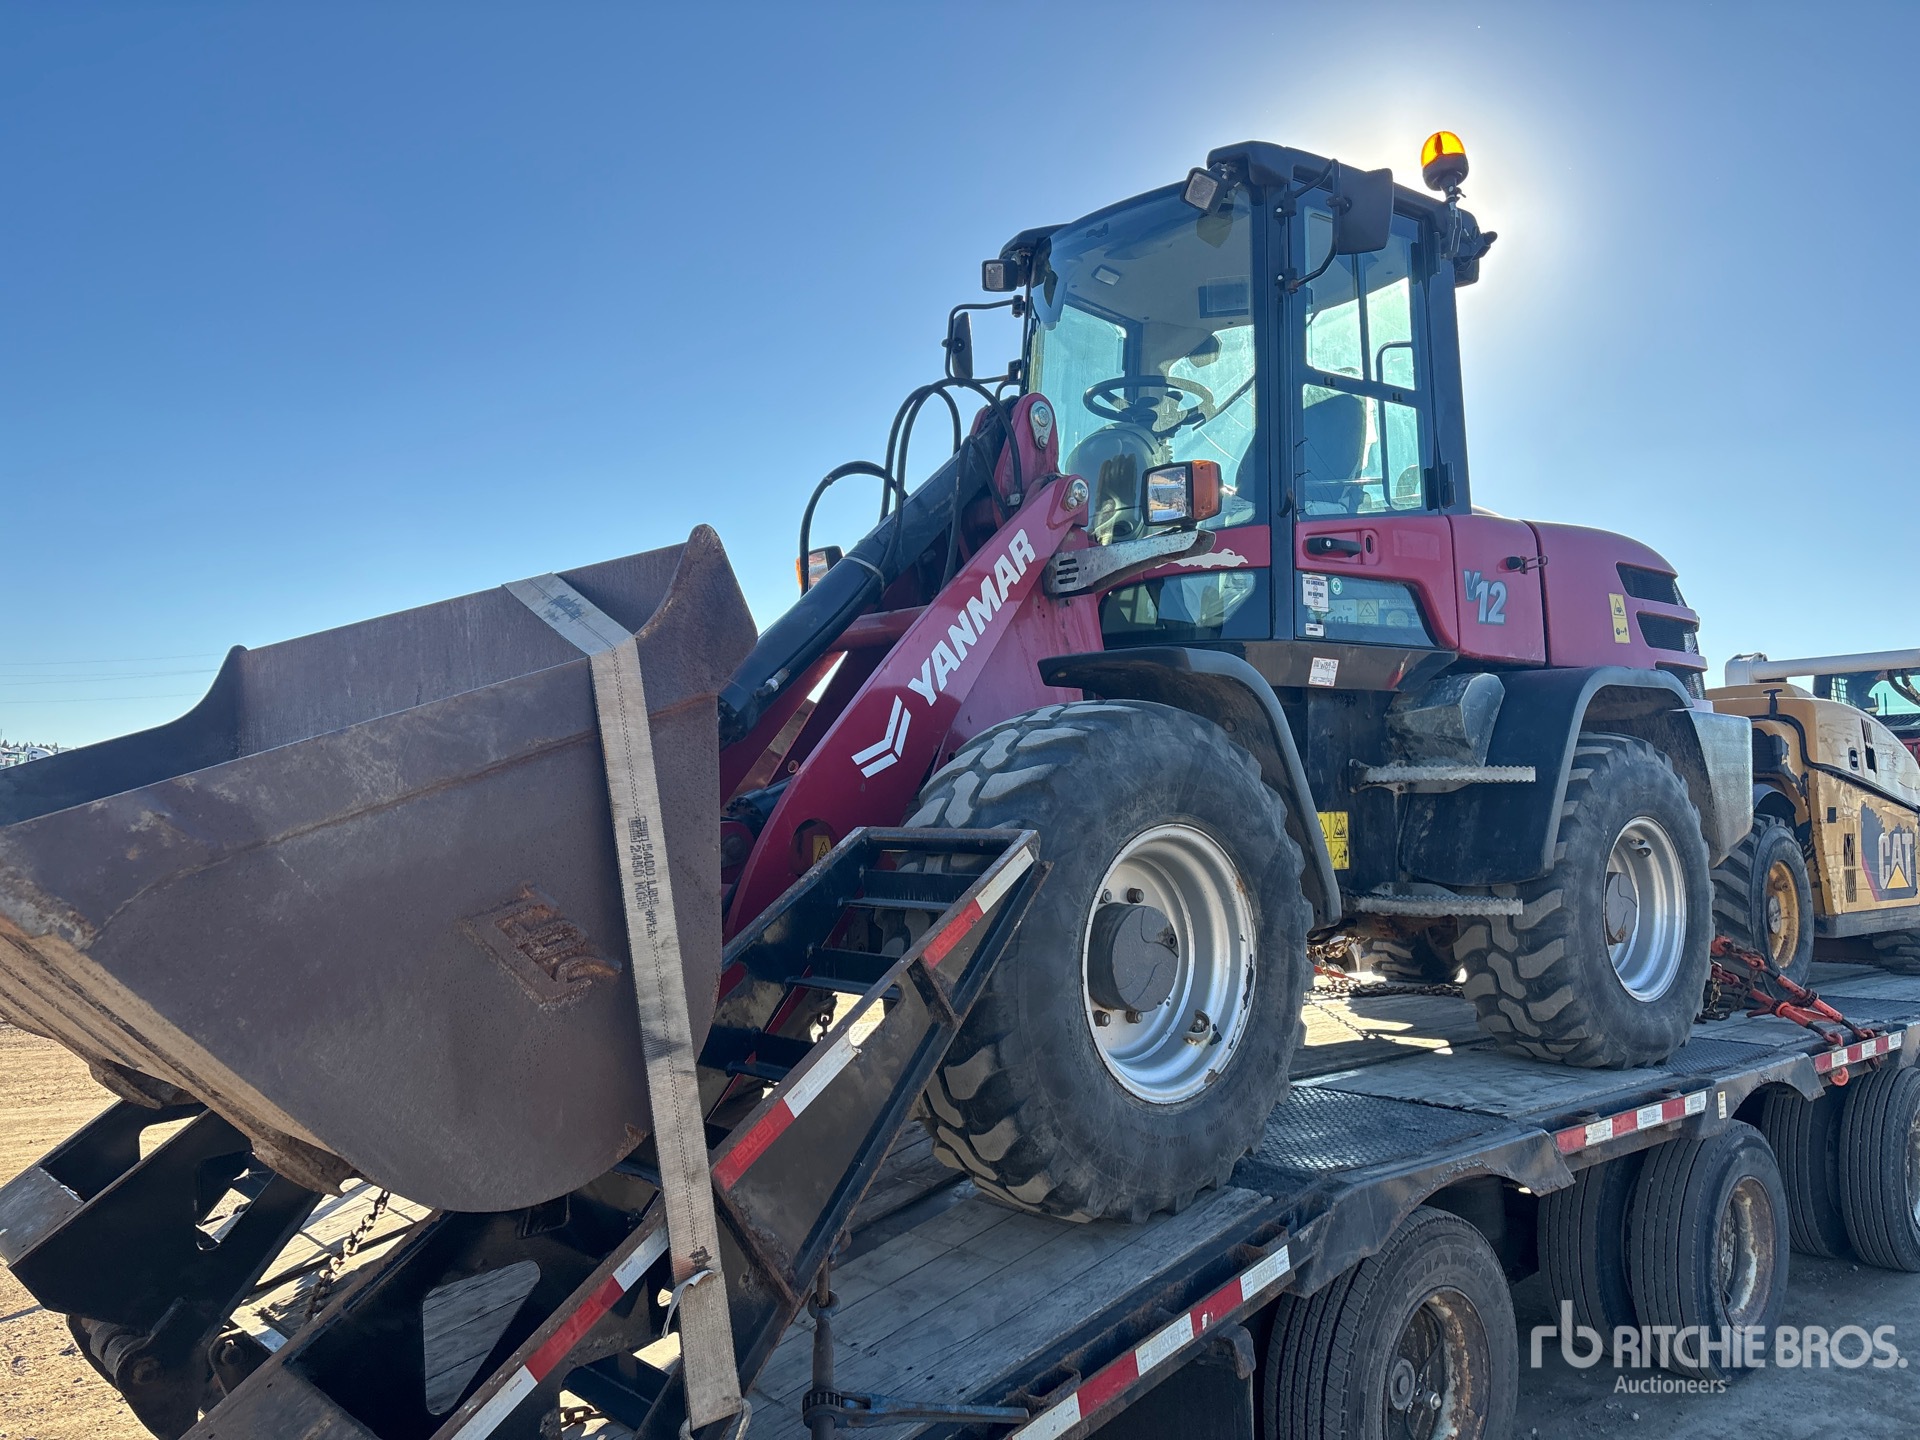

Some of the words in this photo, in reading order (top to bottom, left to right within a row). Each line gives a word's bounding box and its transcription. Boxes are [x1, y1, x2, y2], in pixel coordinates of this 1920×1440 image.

[908, 528, 1036, 706] YANMAR
[1463, 570, 1507, 625] V12
[1879, 832, 1914, 889] CAT
